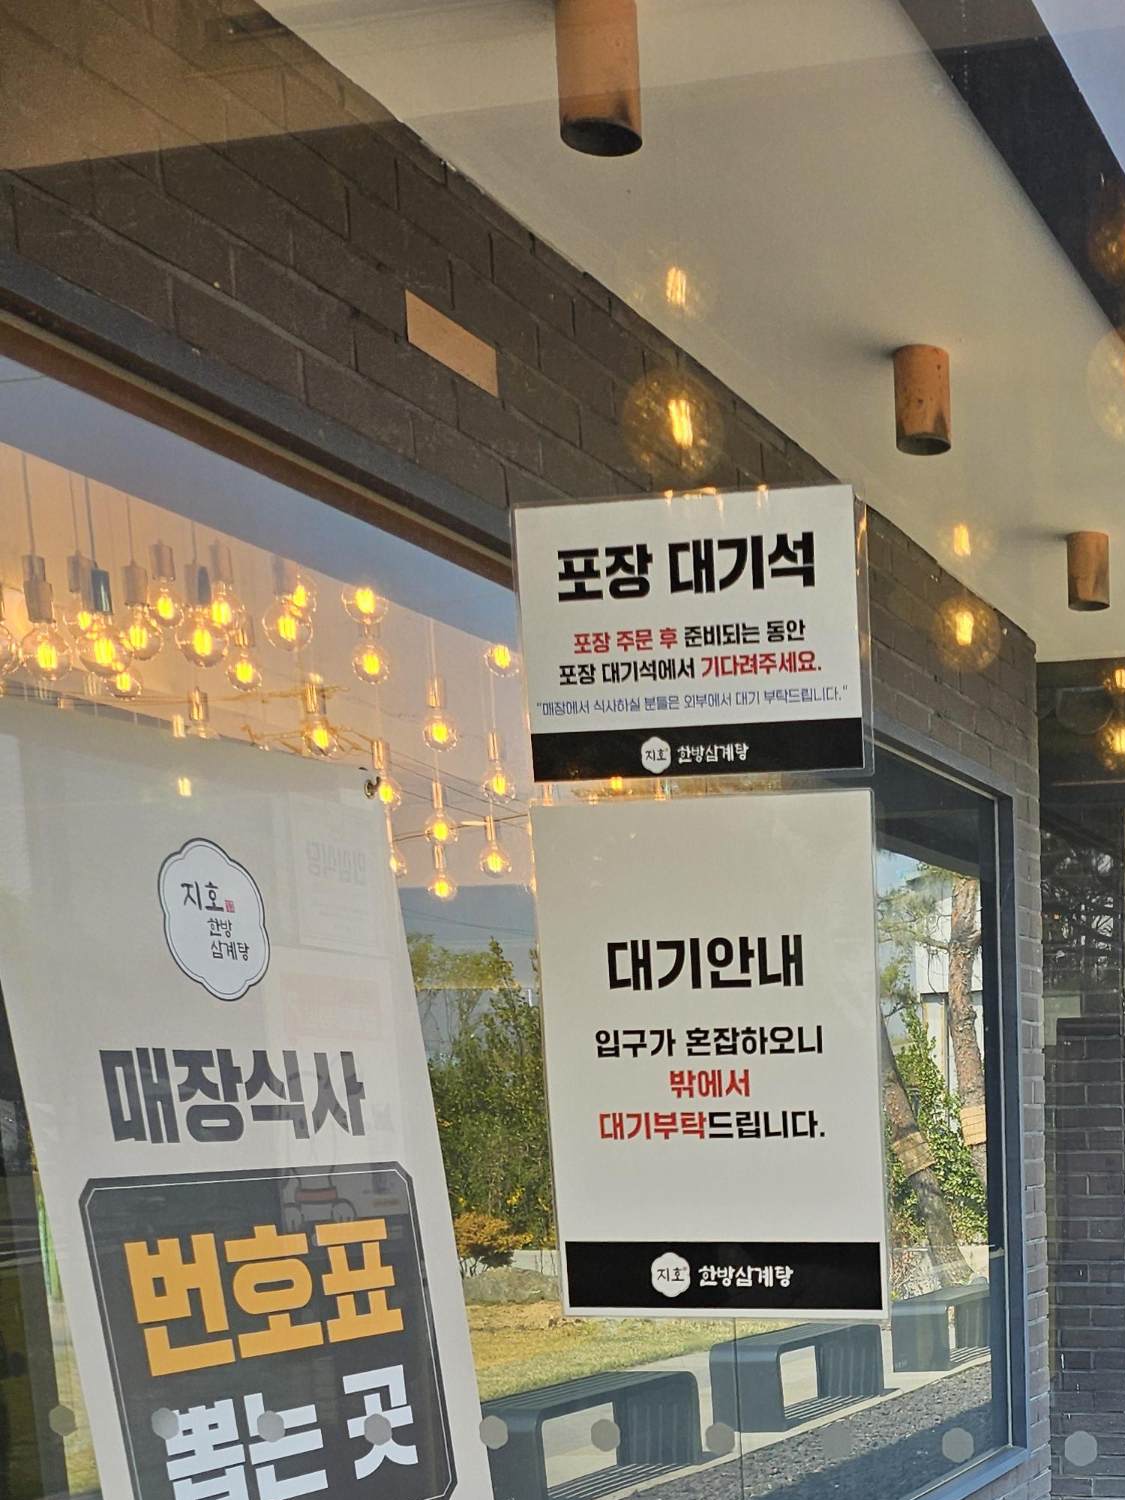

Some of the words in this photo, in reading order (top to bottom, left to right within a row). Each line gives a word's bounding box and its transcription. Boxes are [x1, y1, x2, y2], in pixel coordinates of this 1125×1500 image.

[558, 543, 654, 602] 포장
[668, 531, 816, 595] 대기석
[573, 632, 611, 654] 포장
[616, 628, 653, 651] 주문
[659, 627, 678, 649] 후
[684, 622, 760, 648] 준비되는
[766, 619, 806, 643] 동안
[559, 663, 596, 686] 포장
[602, 658, 696, 685] 대기석에서
[700, 650, 822, 678] 기다려주세요.
[593, 697, 641, 713] 식사하실
[644, 695, 680, 711] 분들은
[684, 692, 732, 708] 외부에서
[735, 690, 760, 706] 대기
[645, 748, 668, 762] 지호
[677, 742, 749, 763] 한방삼계탕
[180, 880, 225, 912] 지호
[207, 918, 233, 938] 한방
[211, 940, 250, 962] 삼계탕
[606, 934, 805, 991] 대기안내
[595, 1028, 676, 1060] 입구가
[685, 1025, 824, 1058] 혼잡하오니
[99, 1047, 367, 1145] 매장식사
[669, 1069, 752, 1099] 밖에서
[599, 1110, 826, 1142] 대기부탁드립니다.
[656, 1267, 685, 1284] 지호
[698, 1264, 795, 1290] 한방삼계탕
[124, 1218, 404, 1378] 번호표
[342, 1363, 420, 1484] 곳
